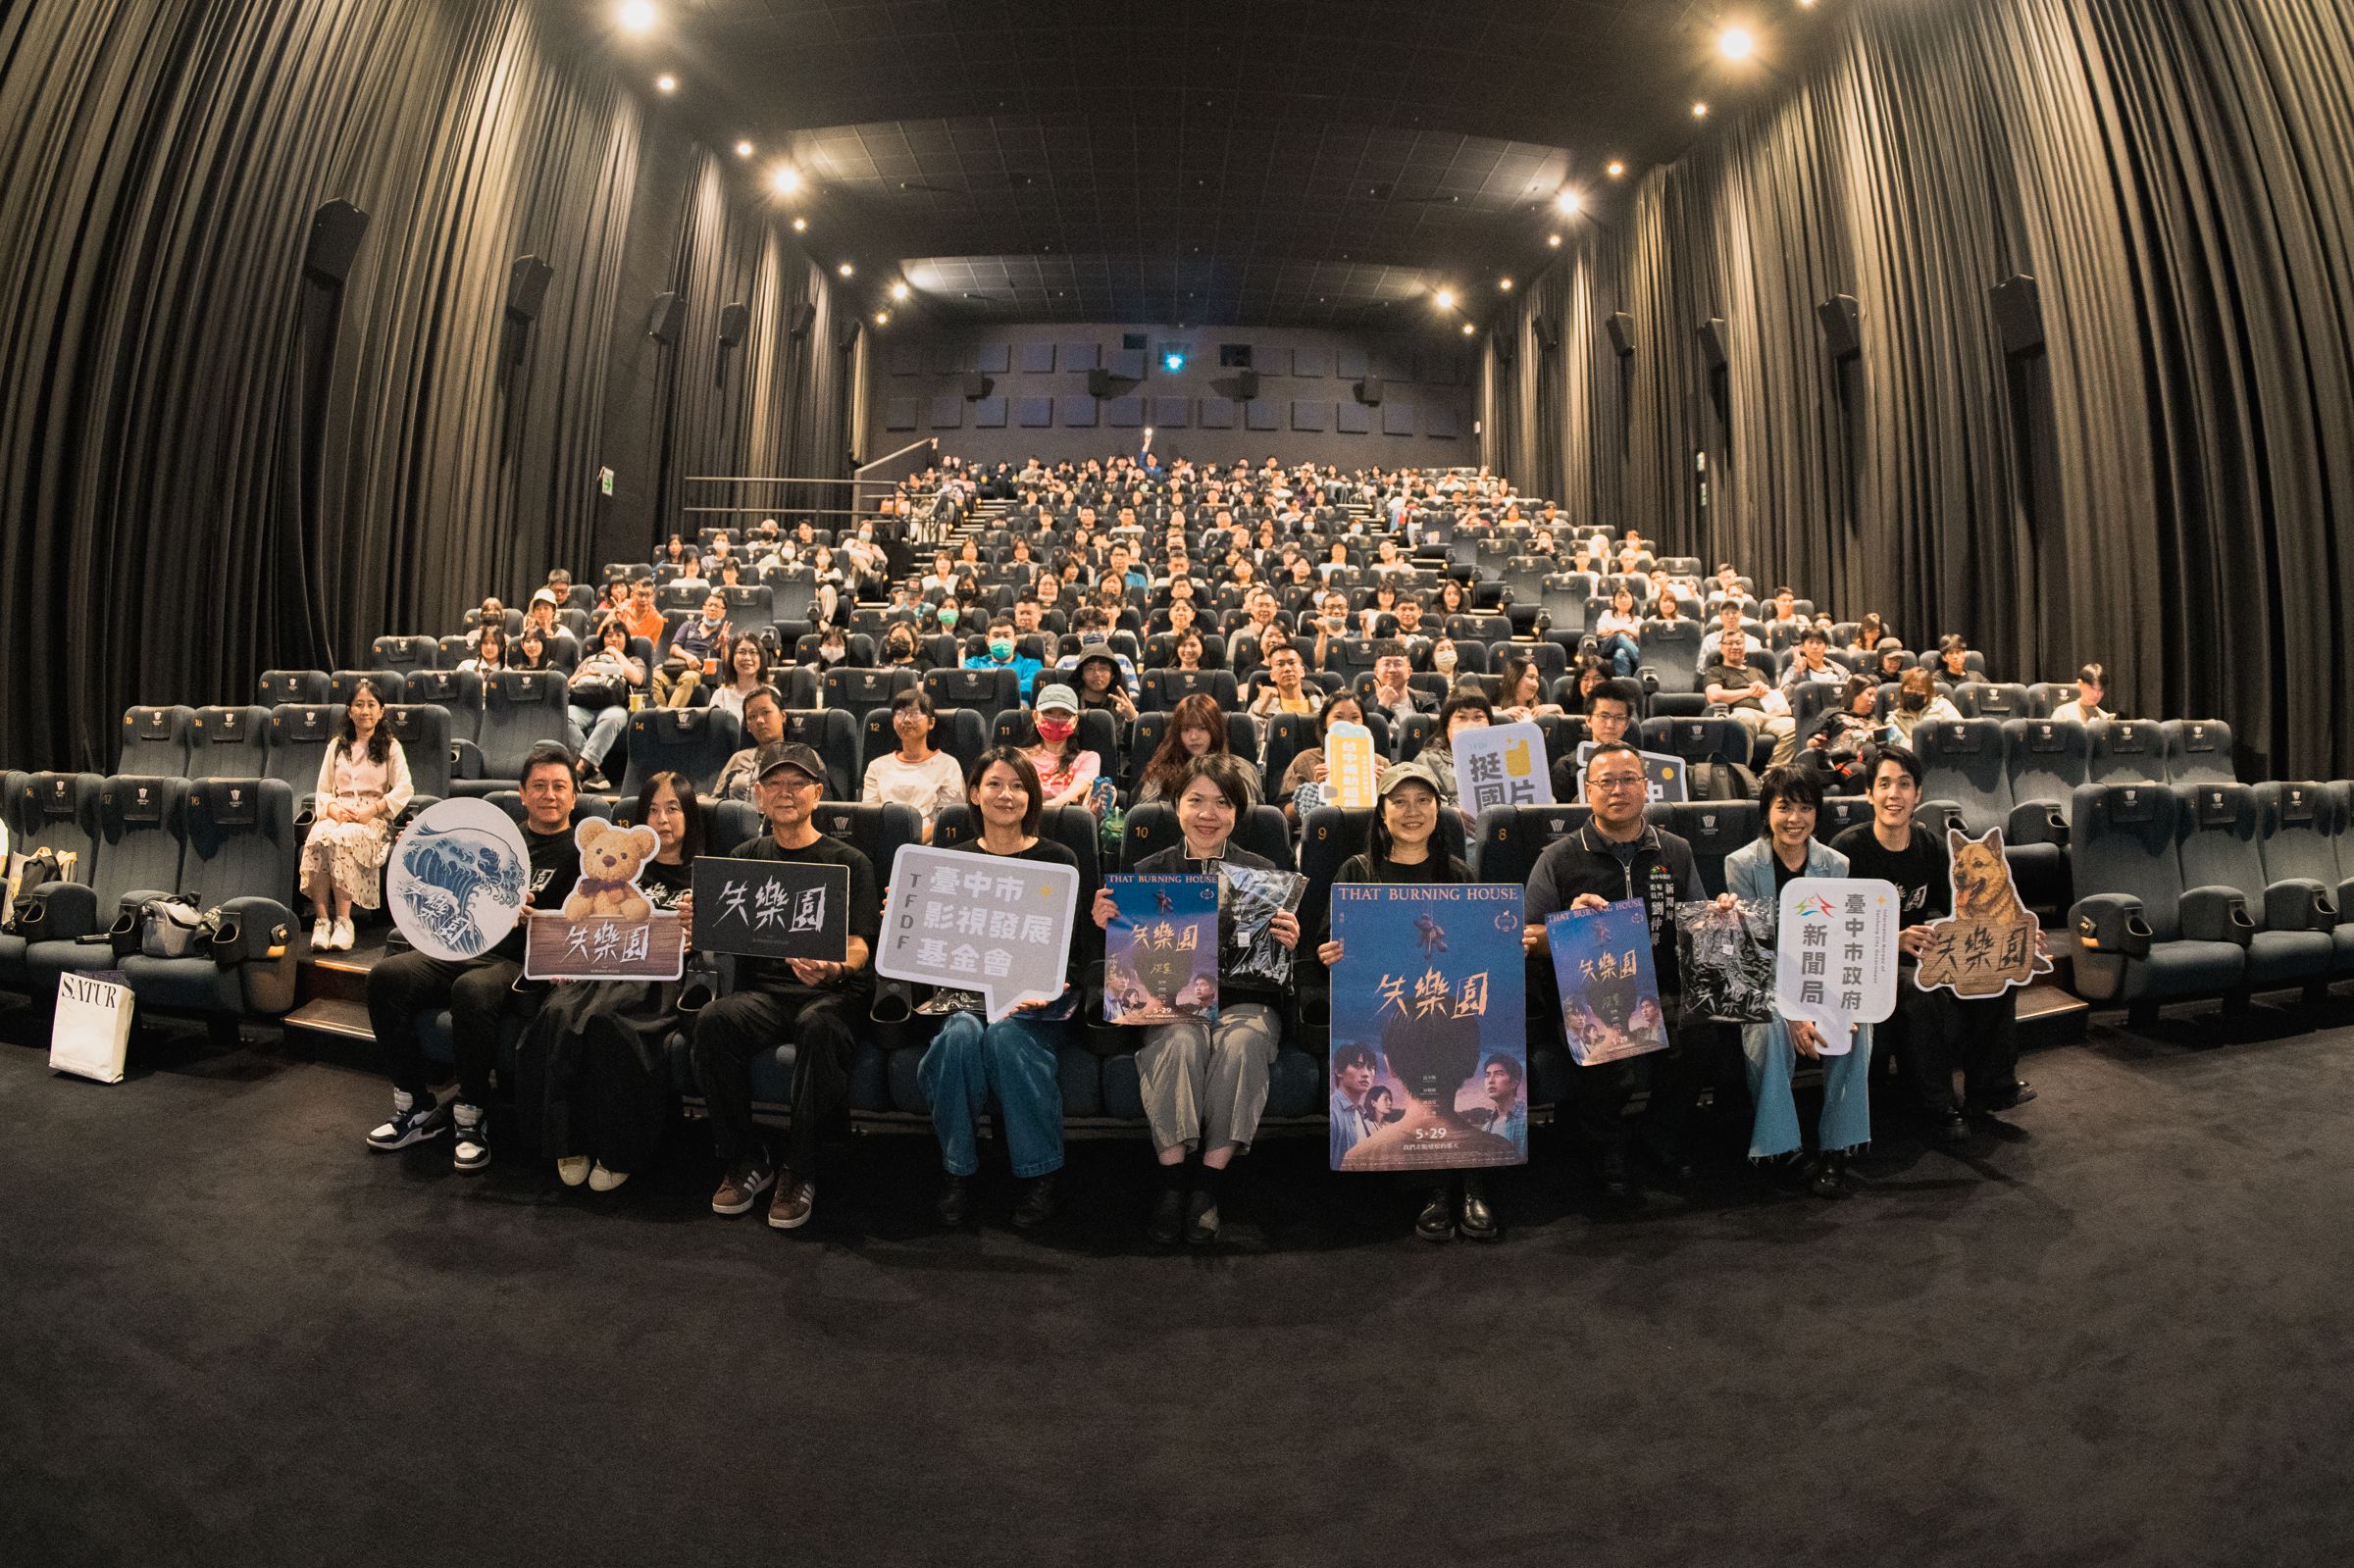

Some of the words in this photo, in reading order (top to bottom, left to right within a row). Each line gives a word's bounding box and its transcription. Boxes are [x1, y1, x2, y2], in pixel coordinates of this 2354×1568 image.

[929, 678, 939, 686] 12
[273, 717, 281, 727] 17
[636, 722, 644, 731] 14
[870, 722, 880, 732] 12
[1000, 726, 1010, 735] 11
[1142, 727, 1151, 736] 10
[1280, 727, 1289, 737] 9
[1413, 728, 1421, 738] 8
[1544, 727, 1552, 737] 7
[1469, 752, 1503, 783] 挺
[103, 794, 112, 805] 17
[190, 796, 200, 806] 16
[1474, 780, 1535, 813] 國片
[618, 820, 629, 829] 13
[946, 827, 956, 838] 11
[1136, 827, 1149, 838] 10
[1318, 827, 1327, 839] 9
[1499, 828, 1507, 840] 8
[929, 865, 1025, 902] 臺中市
[1109, 875, 1134, 884] THAT
[1138, 875, 1182, 884] BURNING
[1185, 875, 1218, 884] HOUSE
[1339, 887, 1381, 900] THAT
[1389, 887, 1459, 900] BURNING
[1466, 887, 1517, 900] HOUSE
[712, 875, 827, 933] 失樂園
[403, 875, 472, 946] 失樂園
[1548, 912, 1570, 922] THAT
[1615, 900, 1645, 911] HOUSE
[923, 900, 1053, 945] 影視發展
[559, 919, 650, 964] 失樂園
[1130, 920, 1200, 952] 失樂園
[1840, 893, 1866, 1010] 臺中市政府
[1930, 924, 2028, 974] 失樂園
[916, 937, 1013, 978] 基金會
[1579, 949, 1636, 983] 失樂園
[1800, 924, 1827, 1004] 新聞局
[62, 977, 117, 1008] SATUR
[1371, 965, 1489, 1022] 失樂園
